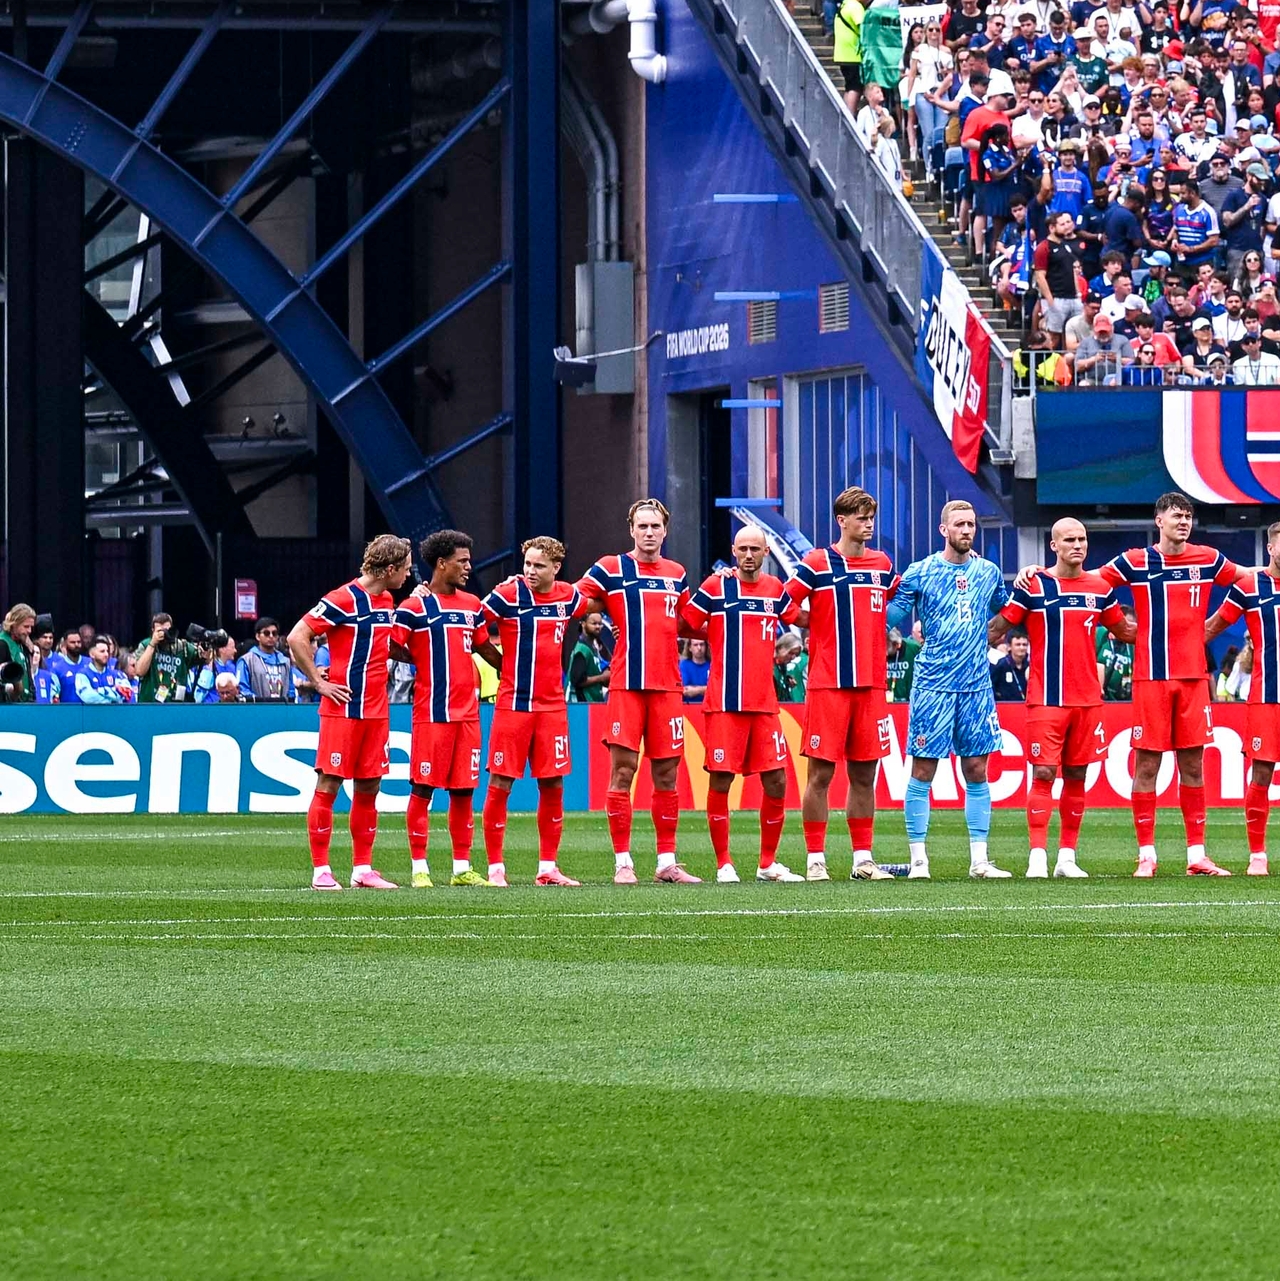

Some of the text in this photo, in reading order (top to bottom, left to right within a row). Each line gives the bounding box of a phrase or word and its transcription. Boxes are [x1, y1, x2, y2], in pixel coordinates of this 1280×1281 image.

[678, 328, 698, 357] WORLD
[699, 326, 710, 354] CUP
[709, 323, 729, 352] 2026
[664, 594, 676, 618] 18
[1189, 585, 1201, 608] 11
[957, 599, 973, 622] 13
[761, 617, 774, 641] 14
[1084, 614, 1095, 635] 4
[669, 716, 683, 740] 18
[1093, 722, 1105, 743] 4
[554, 735, 568, 759] 21
[772, 730, 787, 754] 14
[0, 731, 432, 814] ens
